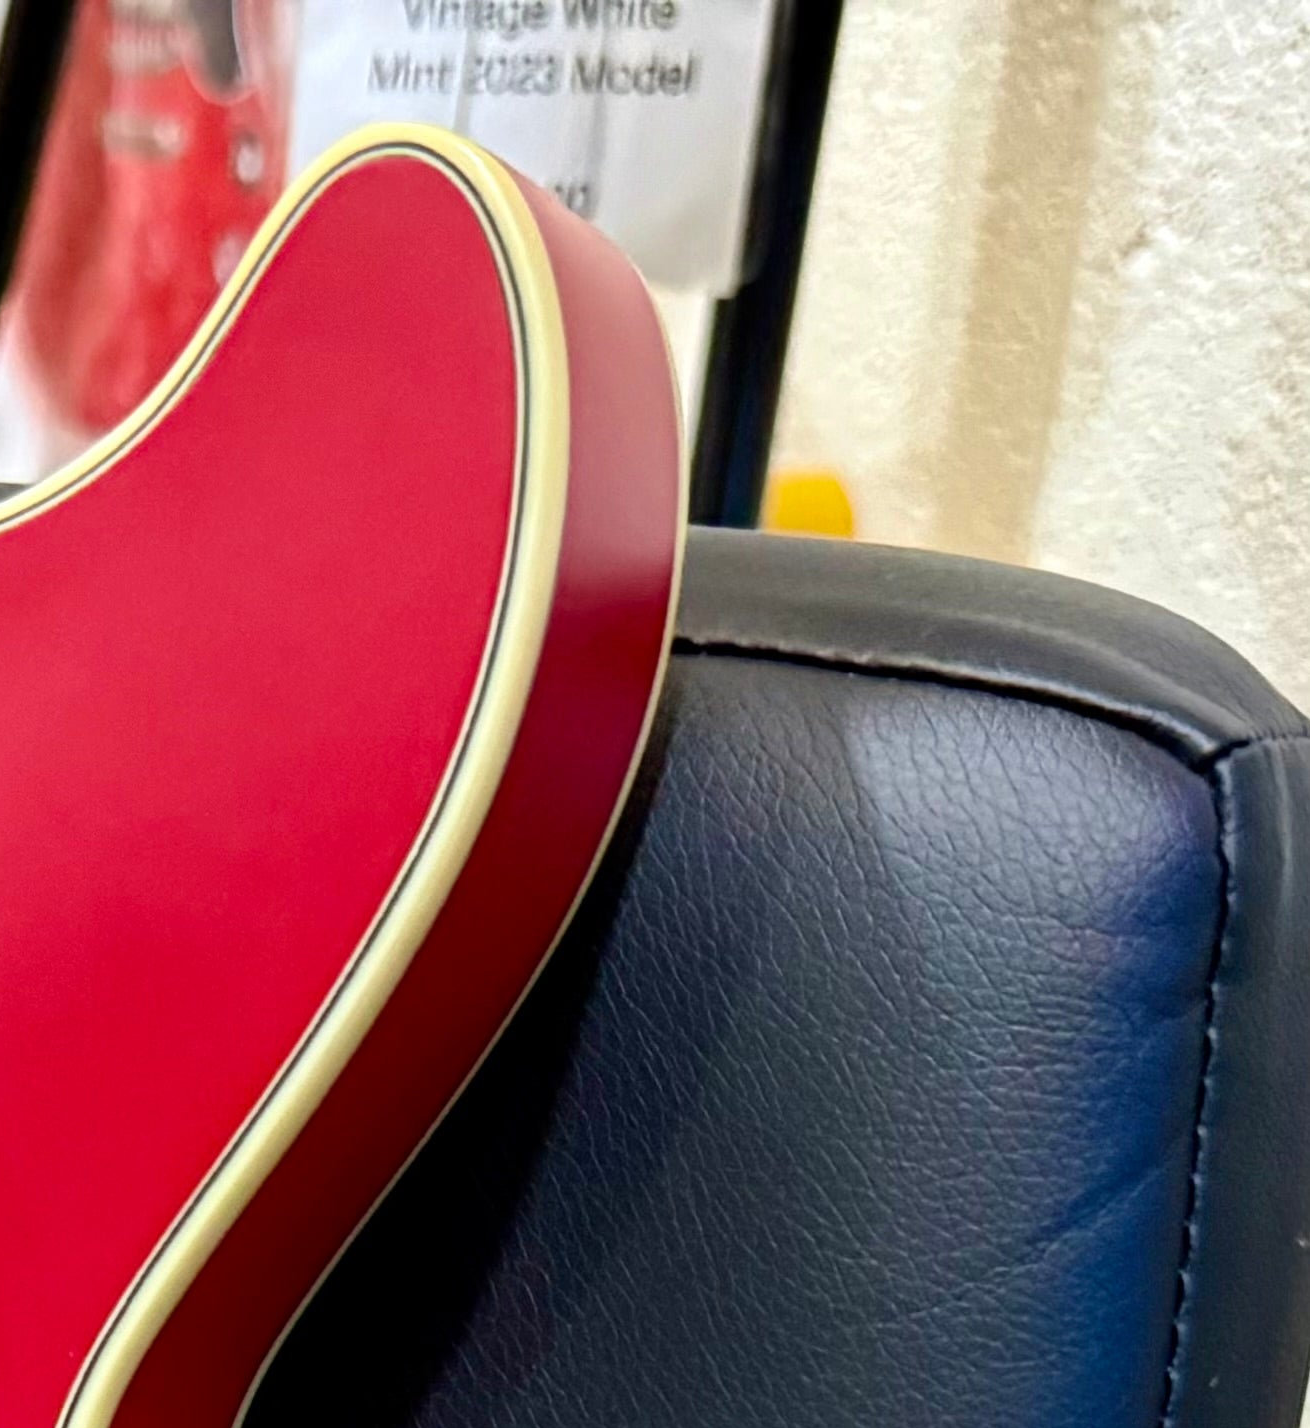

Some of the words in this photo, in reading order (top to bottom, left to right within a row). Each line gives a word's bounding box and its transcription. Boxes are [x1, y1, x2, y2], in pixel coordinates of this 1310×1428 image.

[403, 0, 548, 41] Vintage
[562, 0, 679, 31] White
[368, 52, 455, 96] Mint
[571, 49, 696, 97] Model
